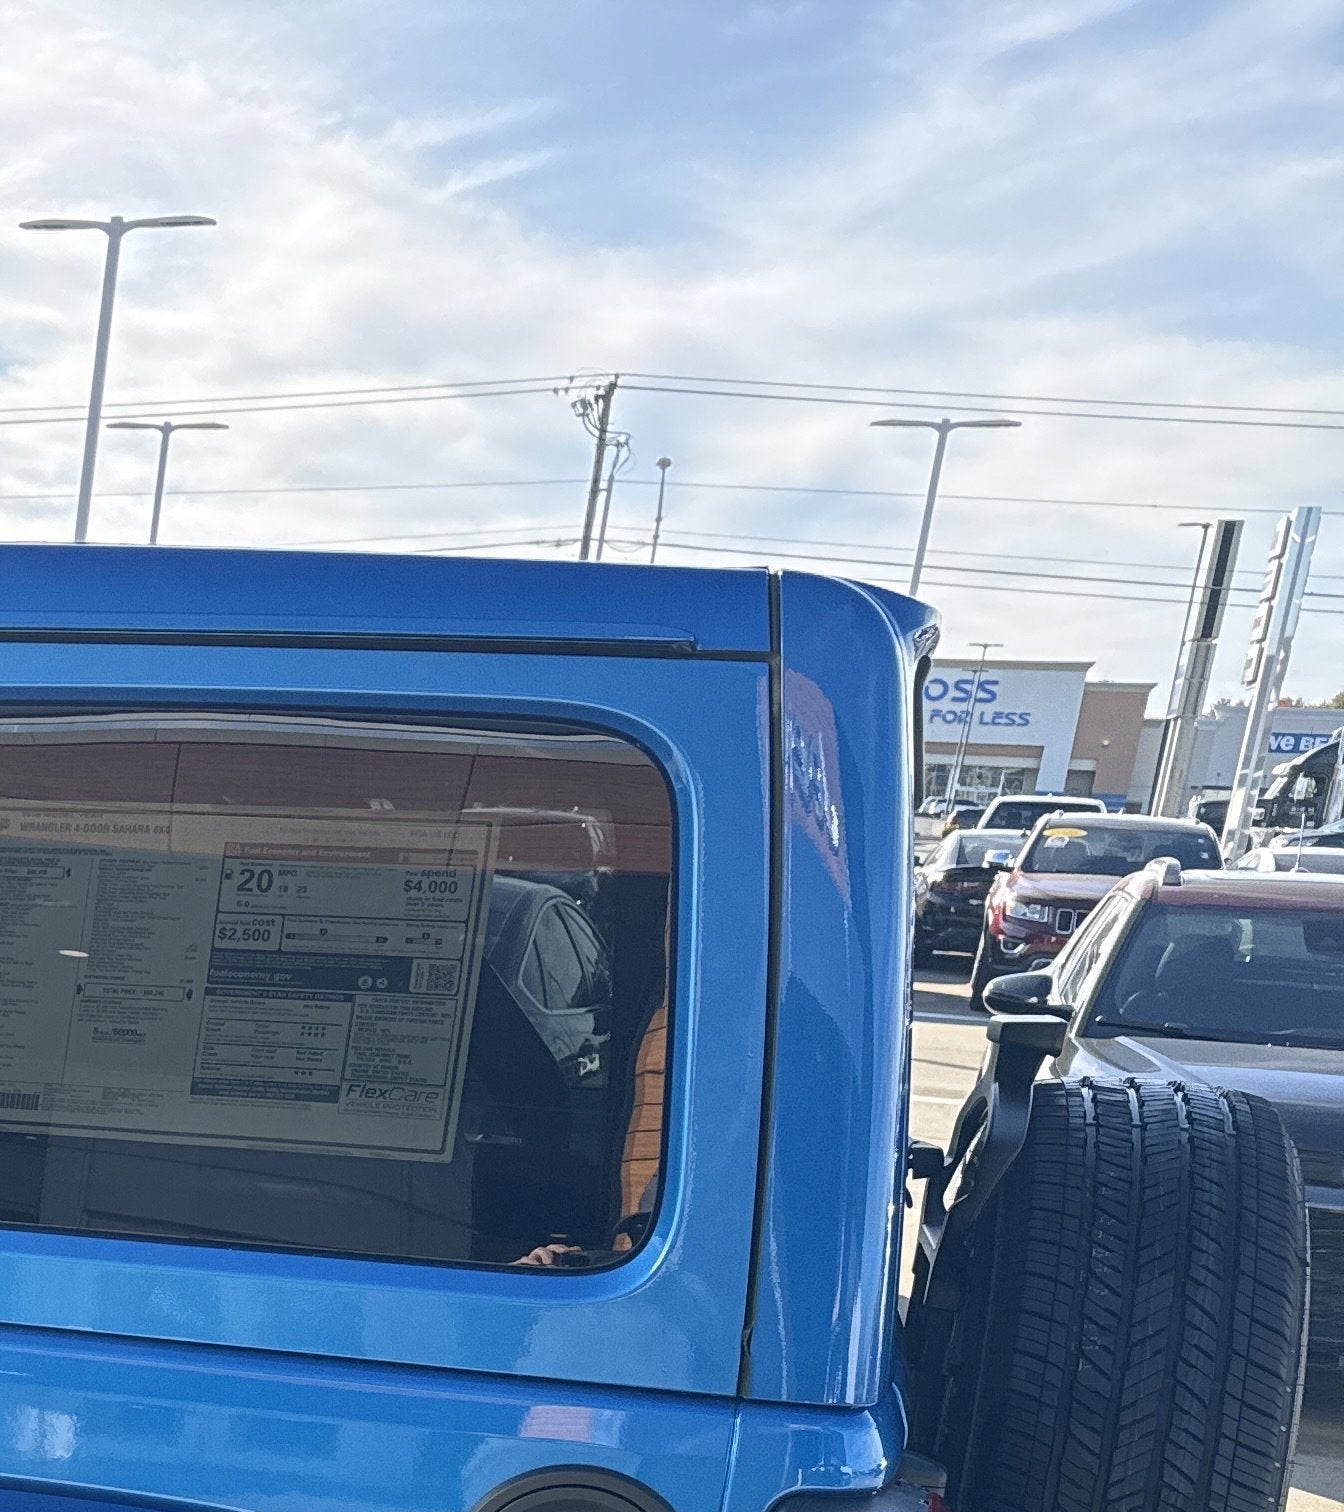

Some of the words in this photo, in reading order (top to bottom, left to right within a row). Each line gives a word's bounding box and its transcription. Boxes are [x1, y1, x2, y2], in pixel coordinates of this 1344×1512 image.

[924, 677, 1000, 703] OSS
[928, 709, 971, 725] FOR
[979, 711, 1032, 727] LESS
[19, 822, 72, 833] WRANGLER
[74, 823, 110, 834] 4-DOOR
[112, 824, 151, 834] SAHARA
[244, 846, 260, 855] Fuel
[263, 847, 299, 857] Economy
[319, 849, 371, 858] Environment
[236, 868, 274, 893] 20
[421, 868, 457, 879] spend
[403, 879, 458, 895] $4,000
[252, 918, 276, 927] cost
[217, 927, 271, 943] $2,500
[346, 1083, 439, 1104] FlexCare
